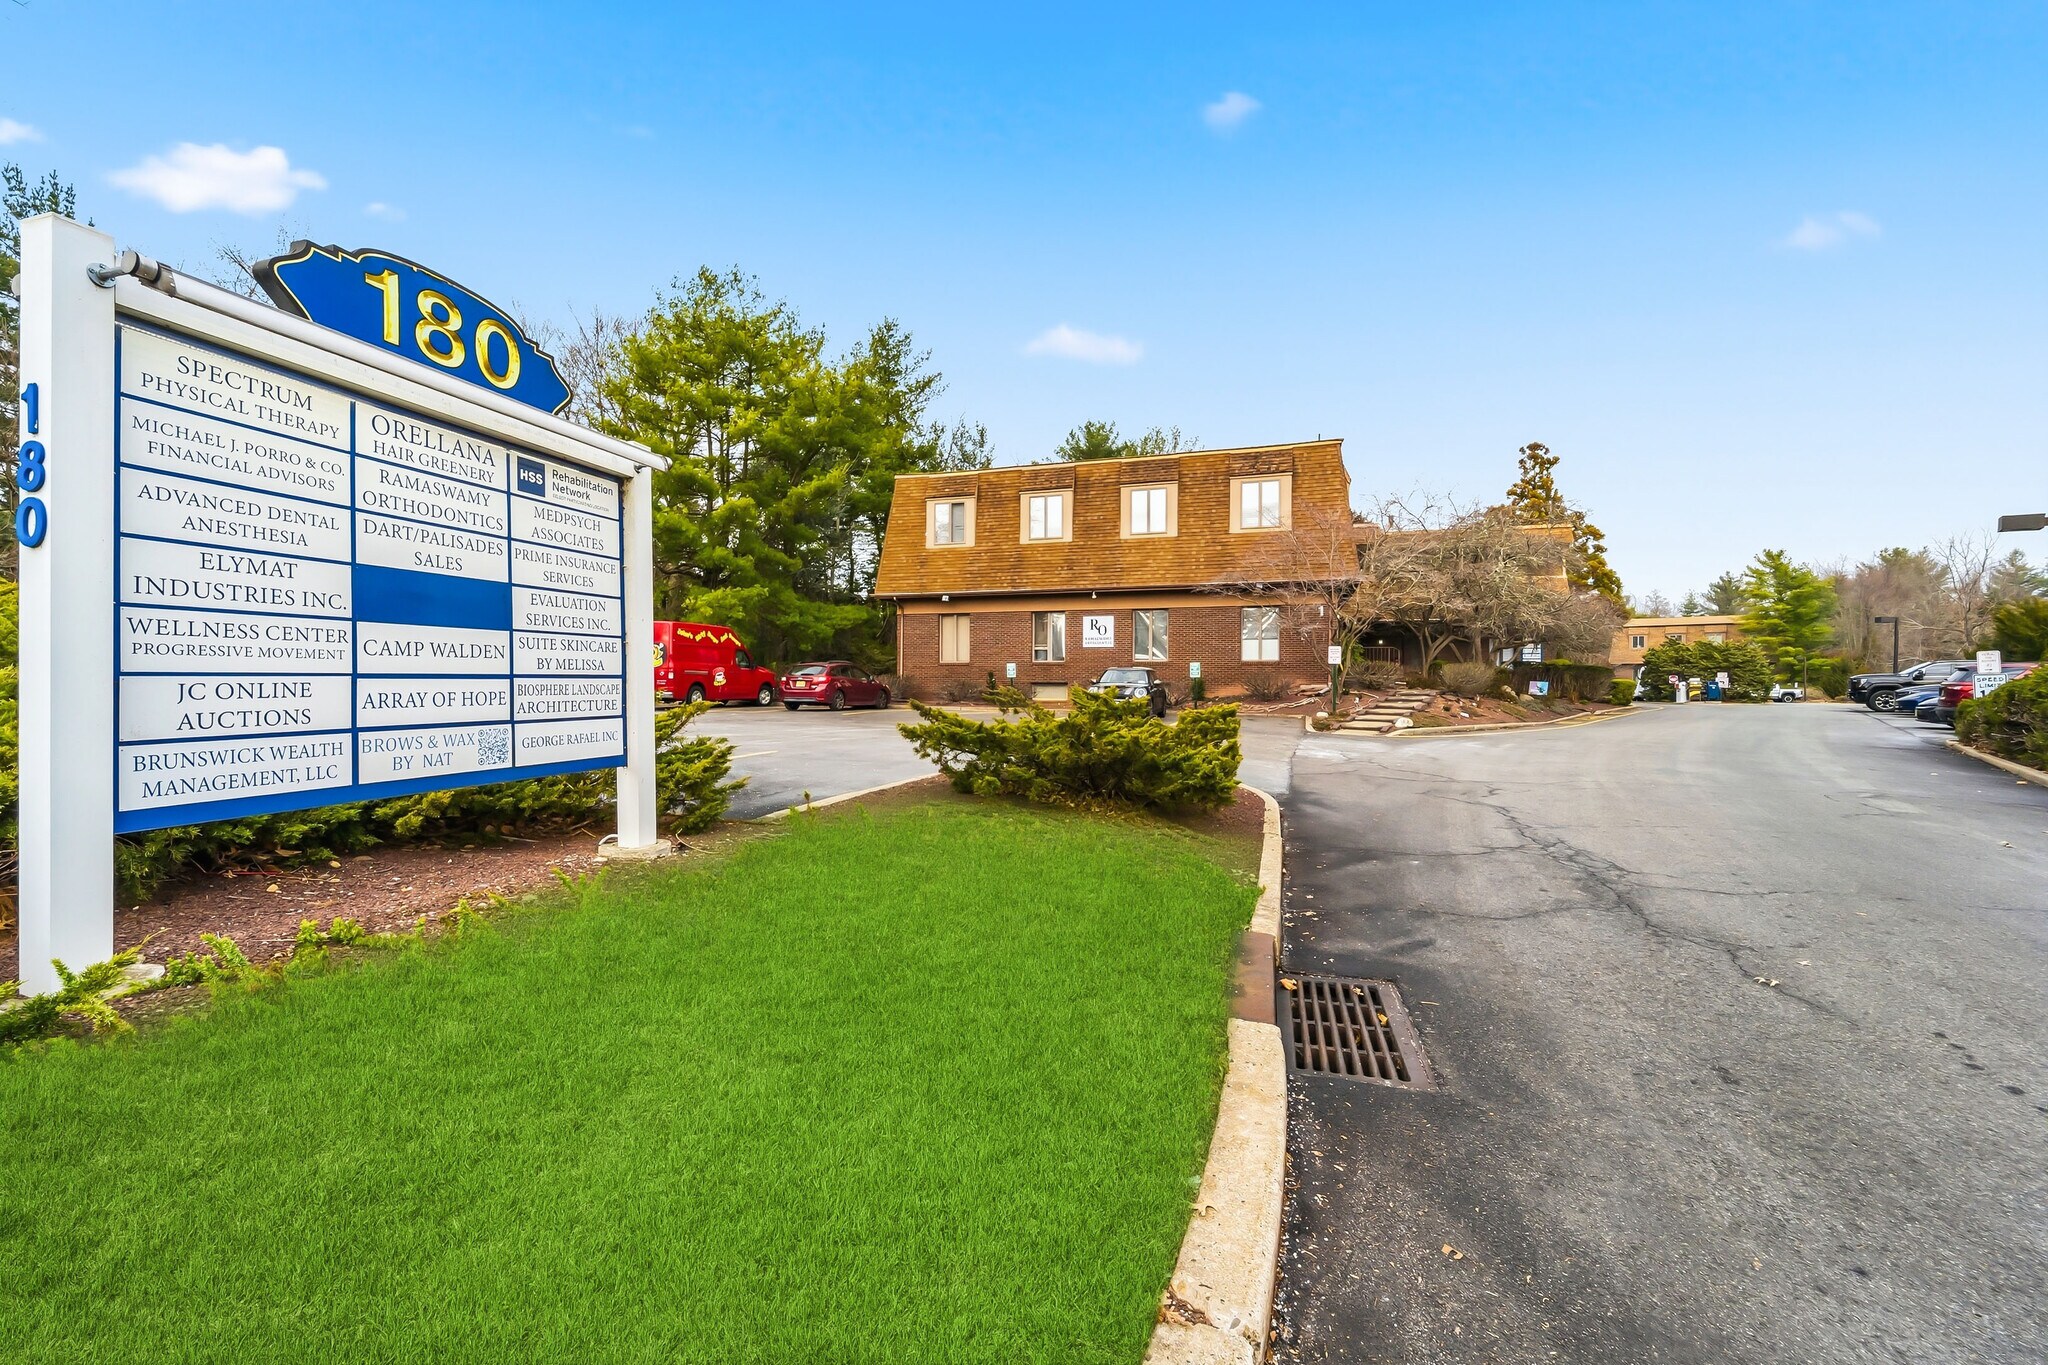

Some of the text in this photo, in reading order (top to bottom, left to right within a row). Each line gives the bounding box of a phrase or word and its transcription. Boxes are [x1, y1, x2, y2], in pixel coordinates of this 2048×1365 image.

[364, 269, 521, 390] 180
[177, 355, 312, 411] SPECTRUM
[141, 372, 340, 439] PHYSICAL THERAPY
[132, 415, 345, 477] MICHAEL J. PORRO & CO.
[371, 414, 496, 467] ORELLANA
[16, 383, 47, 548] 180
[147, 440, 335, 492] FINANCIAL ADVISORS
[373, 440, 495, 484] HAIR GREENERY
[379, 468, 491, 507] RAMASWAMY
[520, 468, 544, 485] HSS
[552, 469, 614, 496] Rehabilitation
[552, 482, 591, 501] Network
[137, 484, 340, 531] ADVANCED DENTAL
[362, 490, 504, 531] ORTHODONTICS
[533, 506, 601, 532] MEDPSYCH
[181, 515, 308, 547] ANESTHESIA
[363, 518, 503, 556] DART/PALISADES
[531, 526, 604, 551] ASSOCIATES
[199, 551, 298, 579] ELYMAT
[414, 551, 463, 571] SALES
[514, 547, 617, 575] PRIME INSURANCE
[543, 570, 594, 588] SERVICES
[133, 575, 347, 610] INDUSTRIES INC.
[530, 593, 607, 612] EVALUATION
[126, 617, 349, 643] WELLNESS CENTER
[525, 613, 611, 631] SERVICES INC.
[131, 642, 346, 660] PROGRESSIVE MOVEMENT
[363, 639, 506, 660] CAMP WALDEN
[518, 636, 618, 653] SUITE SKINCARE
[536, 657, 605, 671] BY MELISSA
[177, 682, 313, 704] JC ONLINE
[361, 691, 507, 710] ARRAY OF HOPE
[517, 683, 620, 697] BIOSPHERE LANDSCAPE
[176, 708, 312, 731] AUCTIONS
[517, 699, 618, 714] ARCHITECTURE
[361, 733, 476, 754] BROWS & WAX
[521, 730, 618, 749] GEORGE RAFAEL INC
[133, 742, 344, 772] BRUNSWICK WEALTH
[393, 752, 454, 771] BY NAT
[142, 764, 338, 799] MANAGEMENT, LLC
